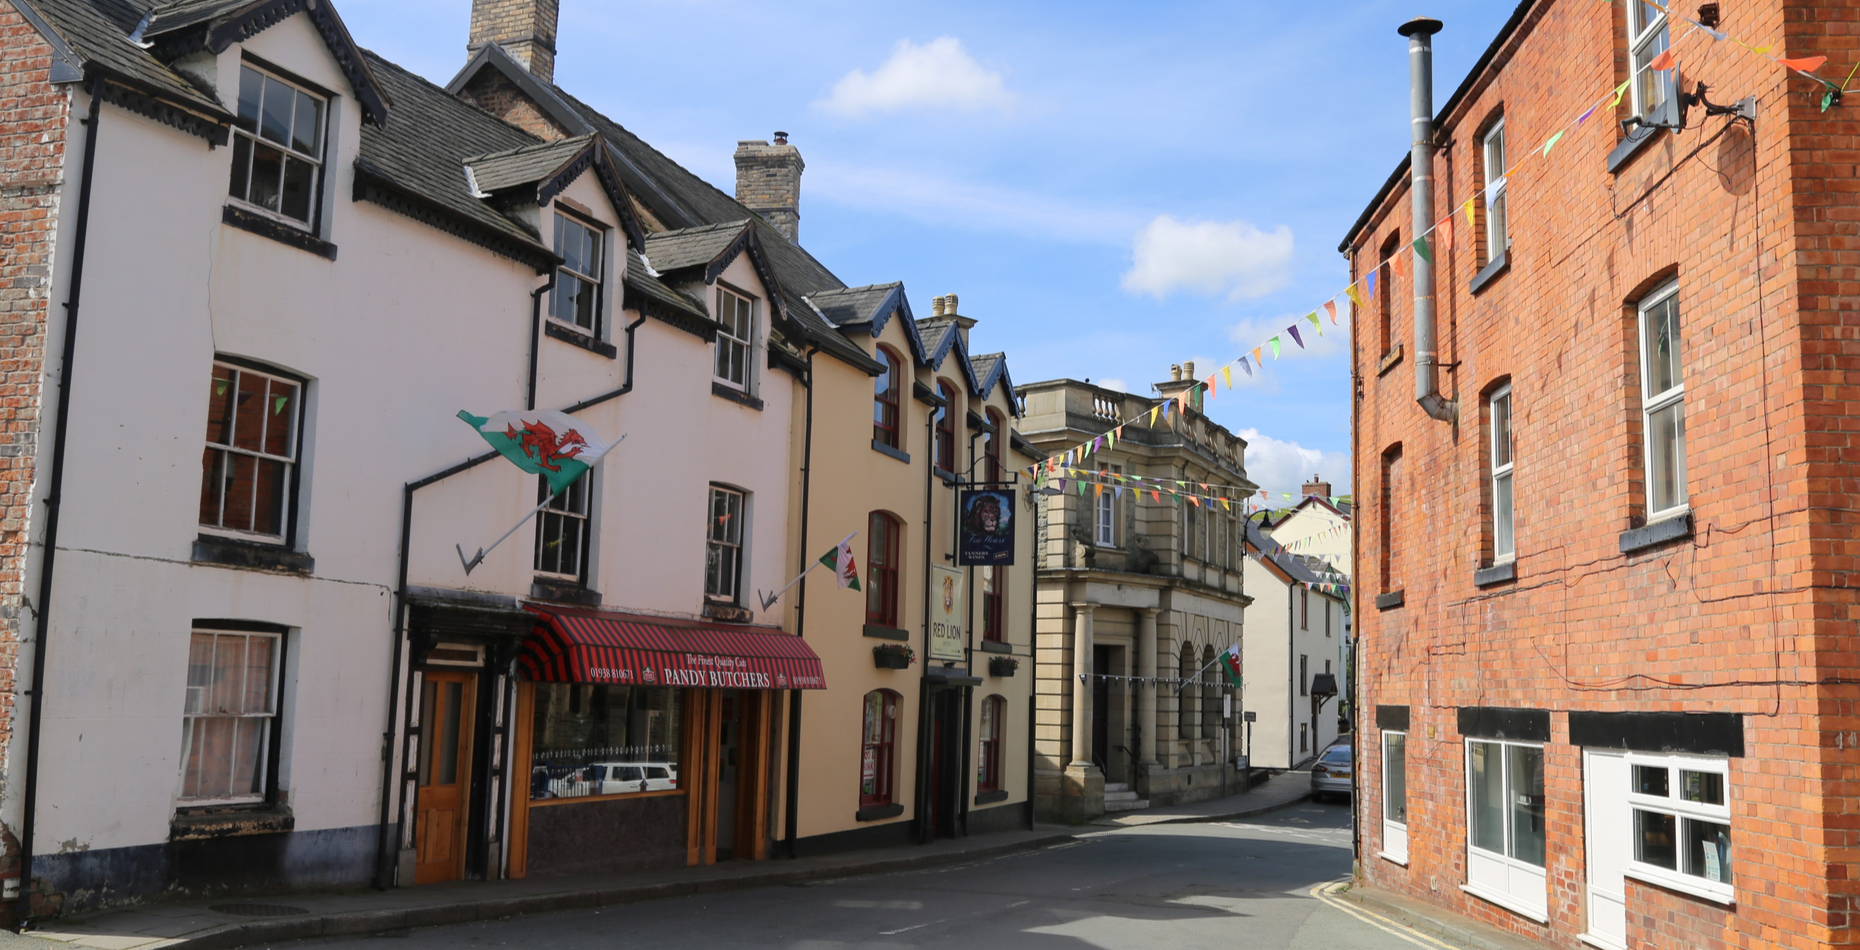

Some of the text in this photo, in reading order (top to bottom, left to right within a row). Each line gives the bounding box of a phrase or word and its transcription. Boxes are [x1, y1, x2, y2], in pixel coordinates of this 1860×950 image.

[933, 622, 961, 640] RED LION
[686, 654, 747, 670] The Finest Quality Cuts
[590, 667, 610, 679] 01938
[611, 669, 634, 680] 810671
[664, 668, 706, 686] PANDY
[709, 670, 770, 688] BUTCHERS
